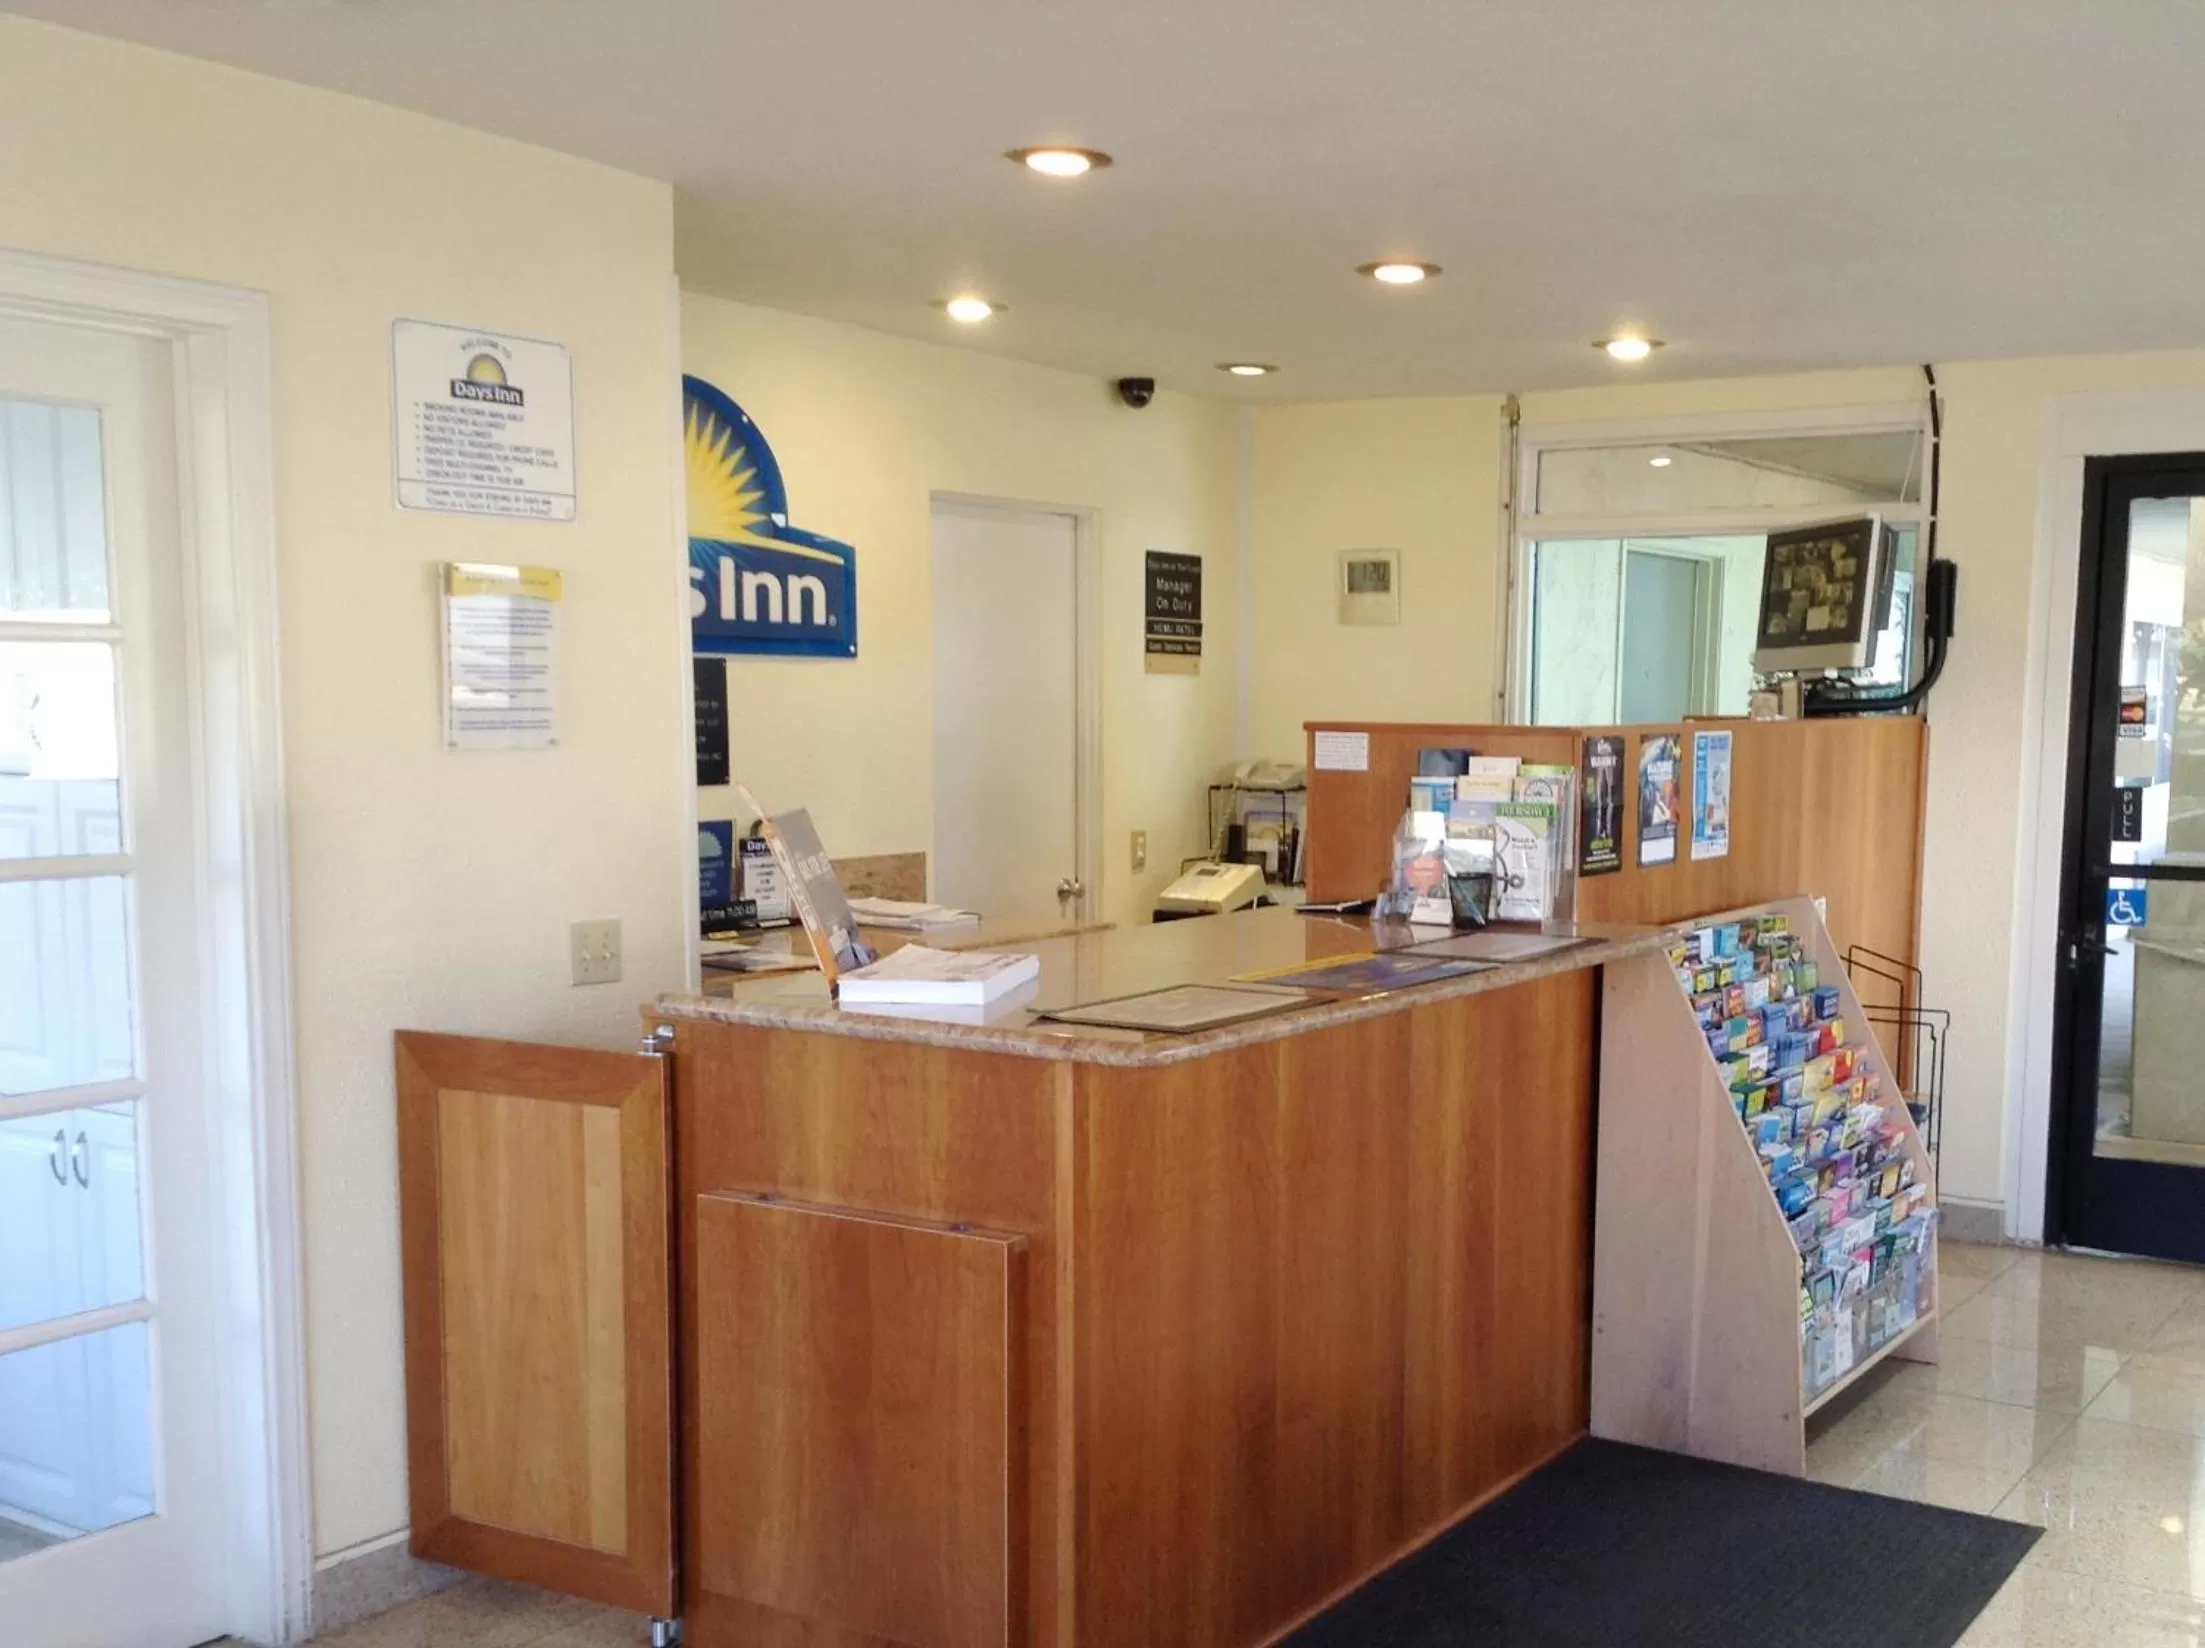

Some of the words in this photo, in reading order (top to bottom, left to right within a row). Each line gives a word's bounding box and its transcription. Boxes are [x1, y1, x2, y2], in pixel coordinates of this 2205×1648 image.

[454, 381, 493, 400] Days
[494, 386, 521, 404] Inn
[718, 555, 828, 626] Inn
[2122, 791, 2134, 838] PULL
